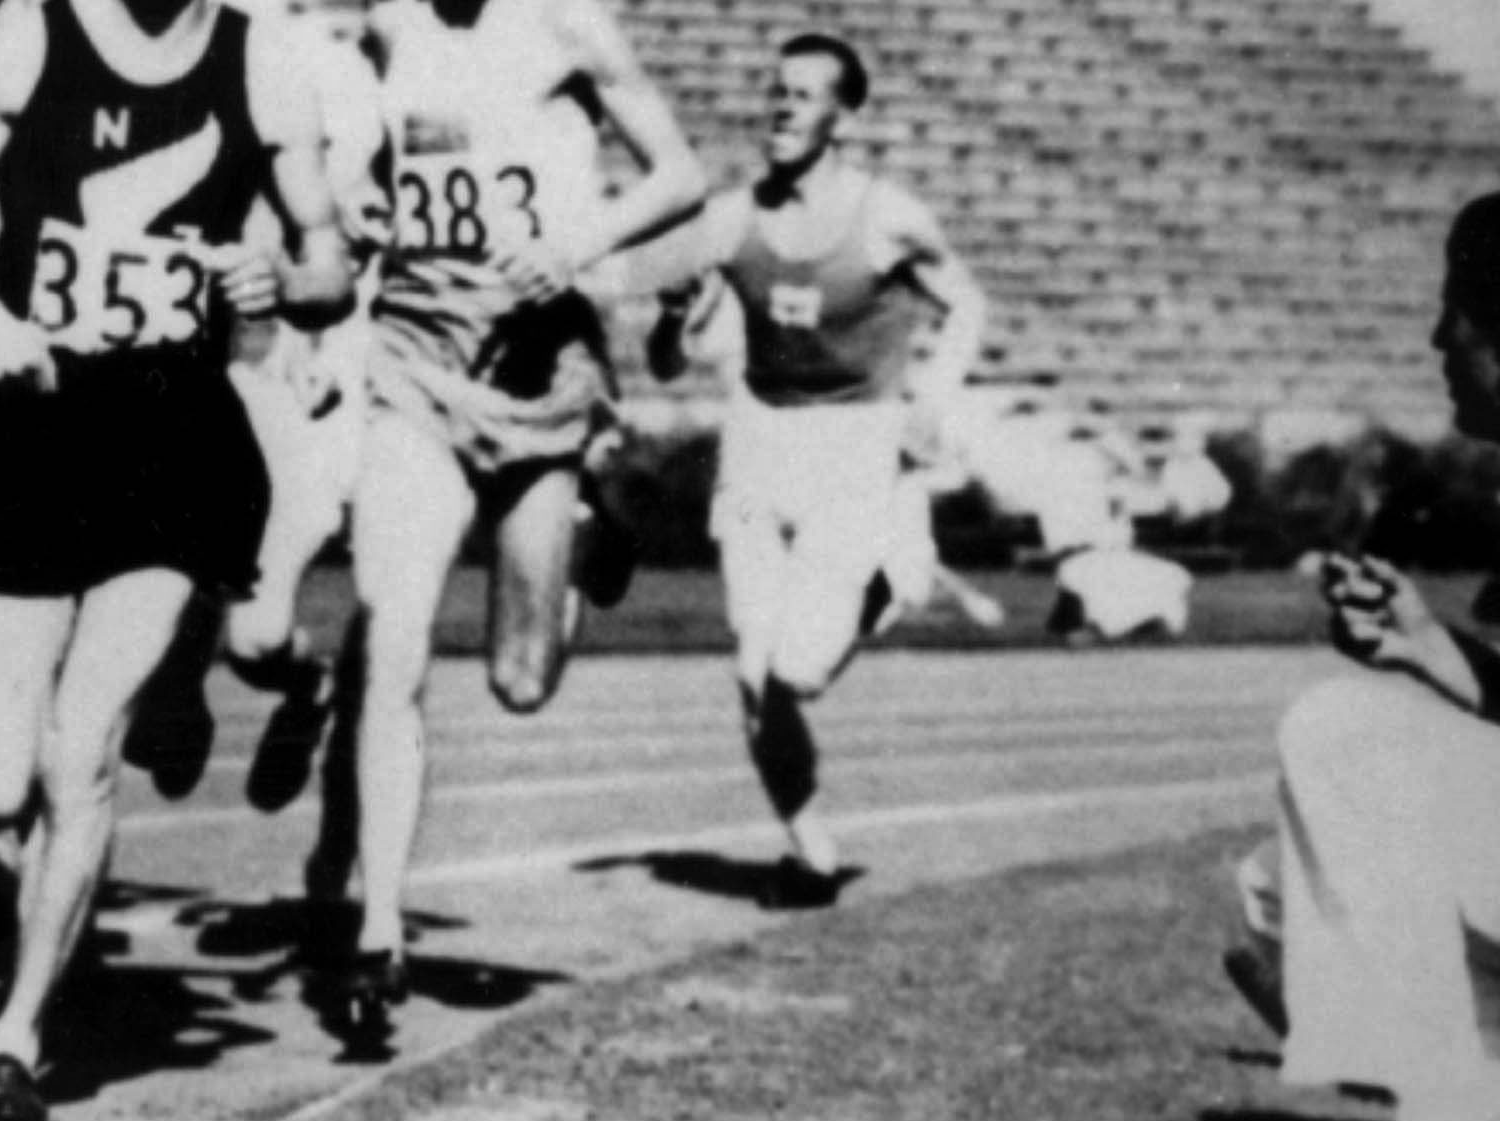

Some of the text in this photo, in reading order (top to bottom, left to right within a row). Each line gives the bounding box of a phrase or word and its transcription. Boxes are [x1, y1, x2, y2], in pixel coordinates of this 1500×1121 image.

[92, 106, 131, 150] N
[398, 165, 541, 253] 383
[33, 237, 205, 344] 353
